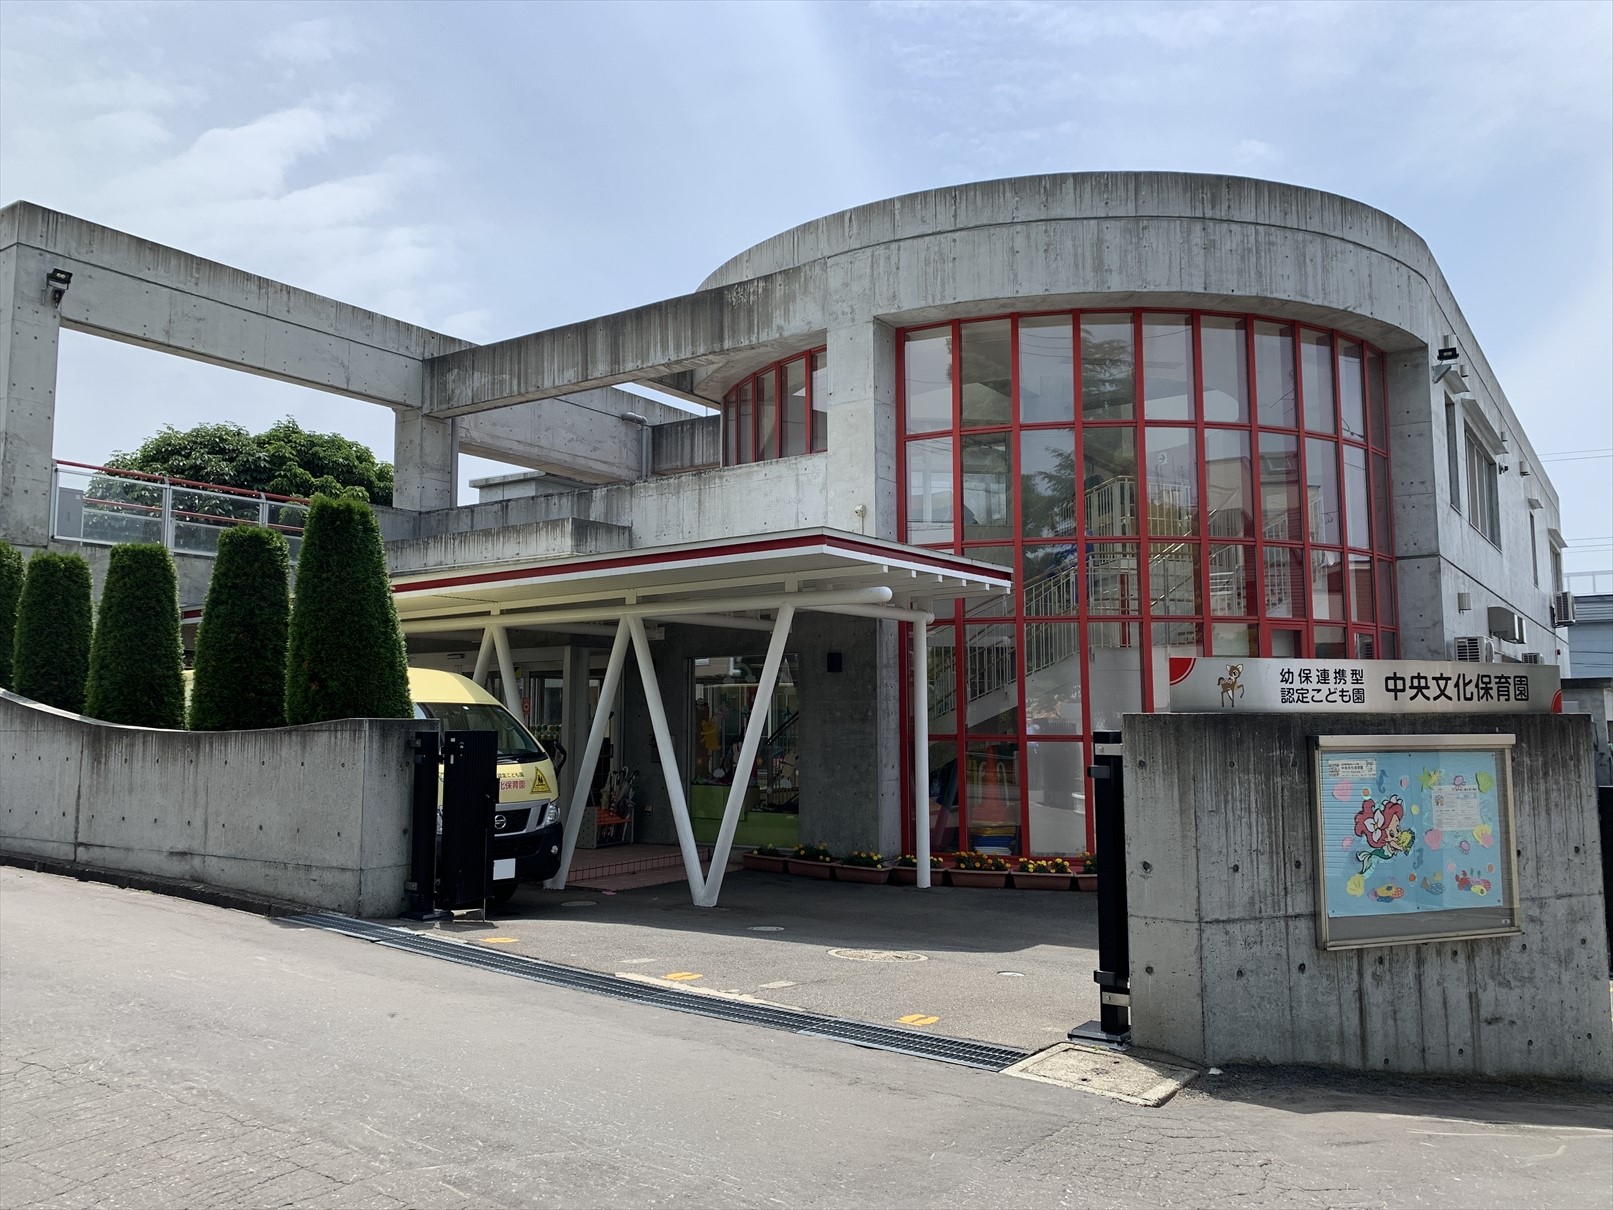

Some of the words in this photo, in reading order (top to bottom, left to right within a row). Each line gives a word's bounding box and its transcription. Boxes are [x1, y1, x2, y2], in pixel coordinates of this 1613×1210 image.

[1279, 668, 1364, 685] 幼保連携型
[1384, 671, 1529, 702] 中央文化保育園
[1280, 687, 1365, 704] 認定こども園
